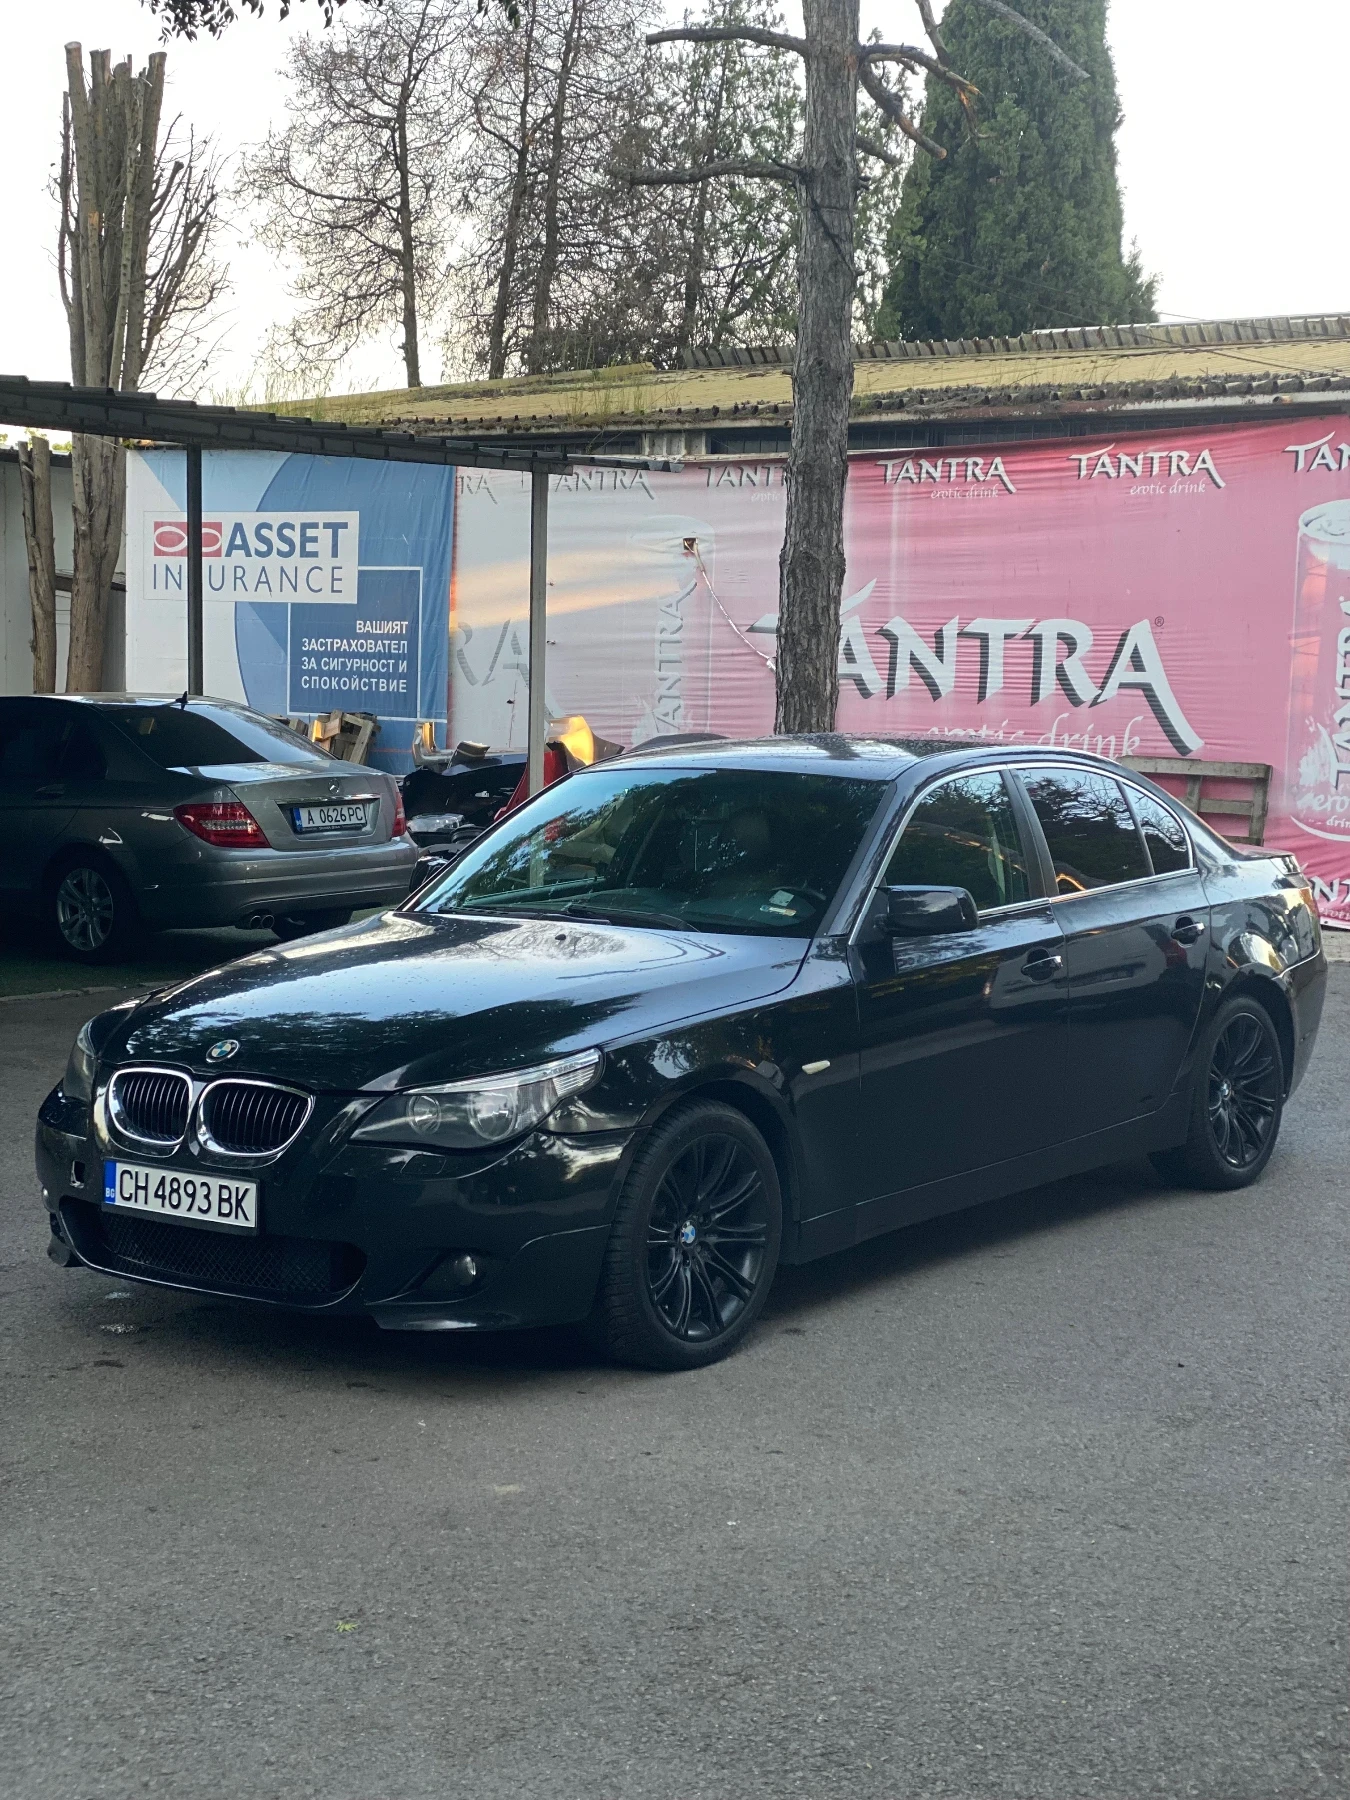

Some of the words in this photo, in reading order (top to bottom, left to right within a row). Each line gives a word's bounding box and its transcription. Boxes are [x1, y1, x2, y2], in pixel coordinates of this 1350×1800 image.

[698, 462, 787, 488] TANT
[875, 451, 1017, 494] TANTRA
[1069, 443, 1226, 489] TANTRA
[554, 466, 654, 500] ANTRA
[966, 484, 999, 499] drink
[1169, 478, 1206, 494] drink
[224, 522, 349, 558] ASSET
[153, 563, 343, 593] INURANCE
[356, 620, 408, 634] ВАШИЯТ
[301, 638, 408, 653] ЗАСТРАХОВАТЕЛ
[652, 578, 698, 733] ANTRA
[301, 657, 317, 670] ЗА
[321, 658, 395, 673] СИГУРНОСТ
[399, 660, 407, 673] И
[745, 577, 1206, 757] ANTRA
[301, 675, 407, 692] СПОКОЙСТВИЕ
[105, 1187, 115, 1199] BG
